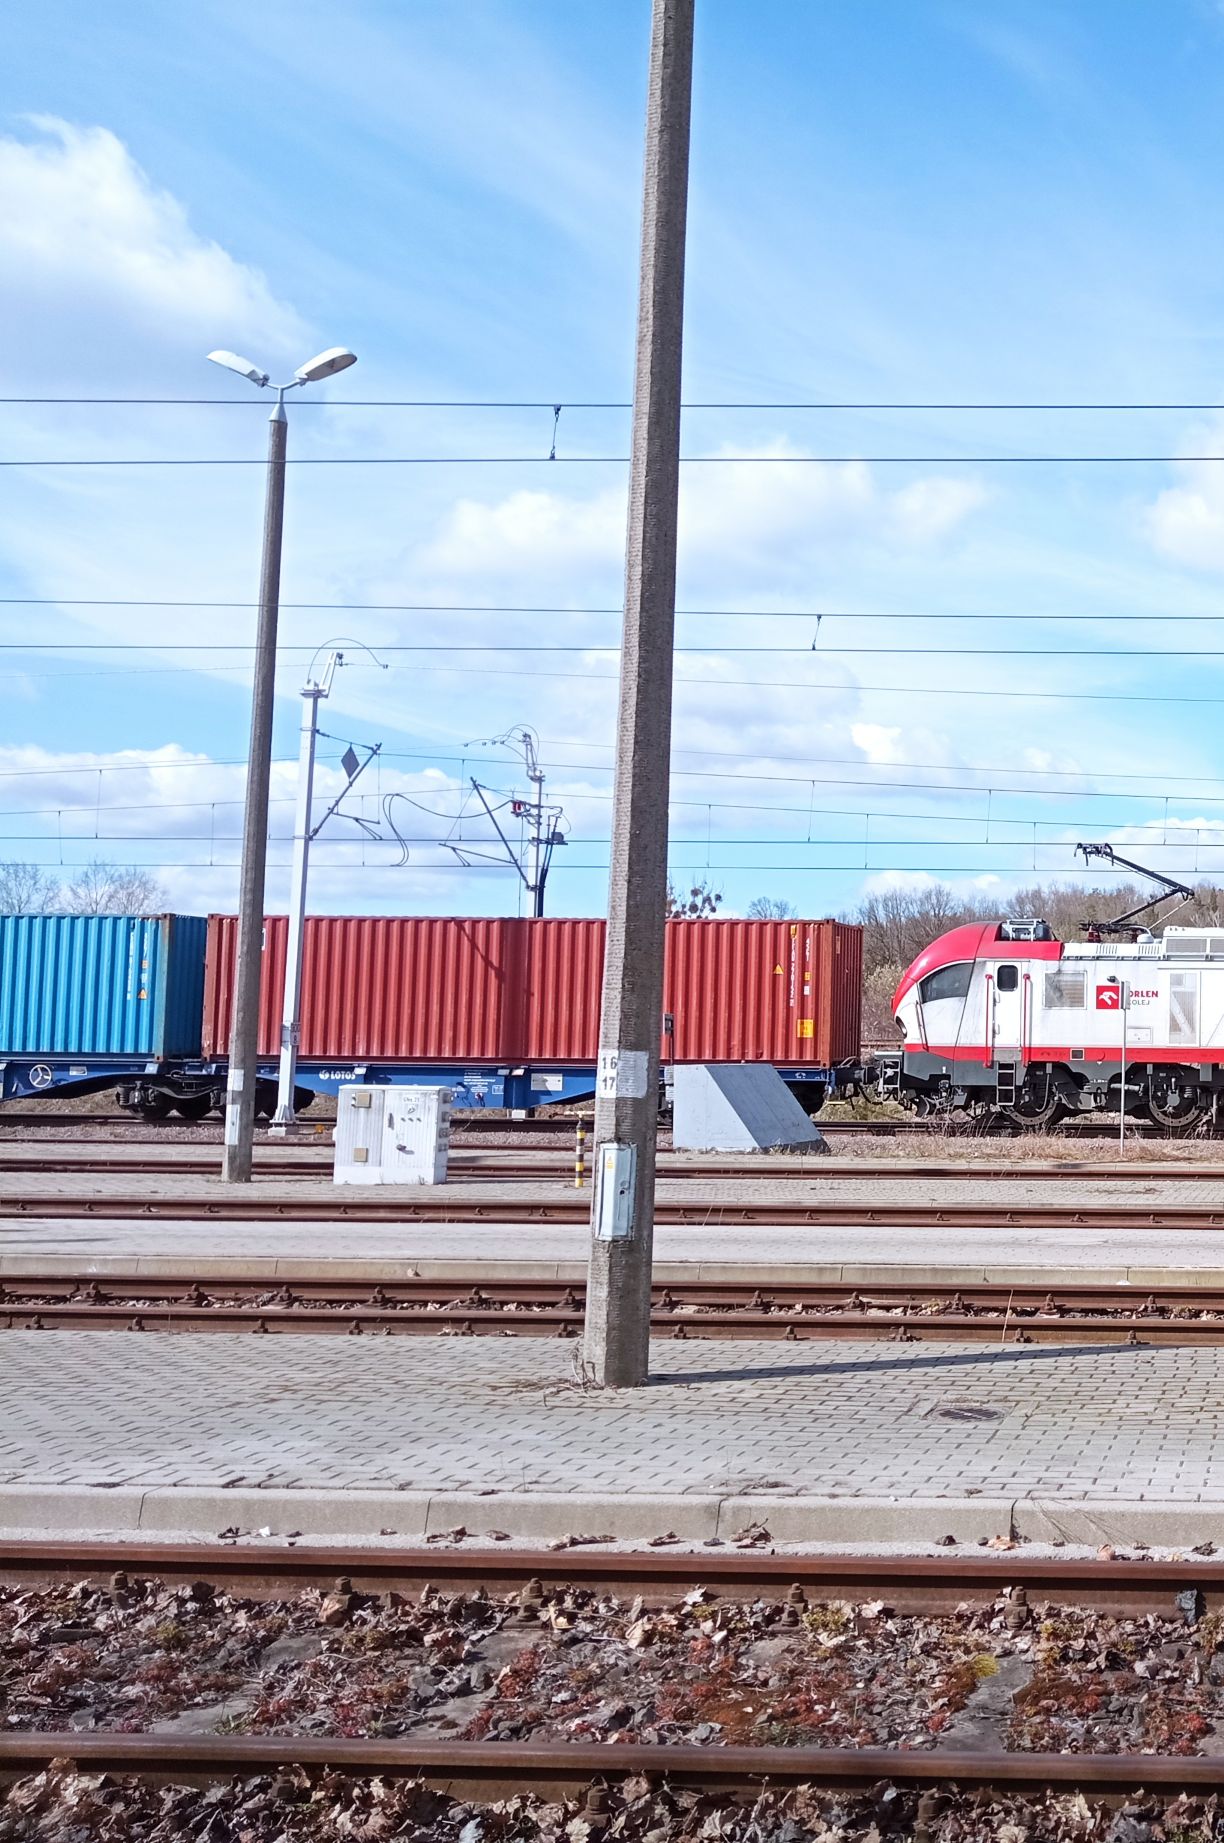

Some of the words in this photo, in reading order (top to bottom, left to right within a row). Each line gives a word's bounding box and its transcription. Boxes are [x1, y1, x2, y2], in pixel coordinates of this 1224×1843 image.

[1129, 990, 1159, 998] ORLEN
[602, 1056, 617, 1070] 16
[331, 1071, 356, 1080] LOTOS
[602, 1076, 616, 1090] 17
